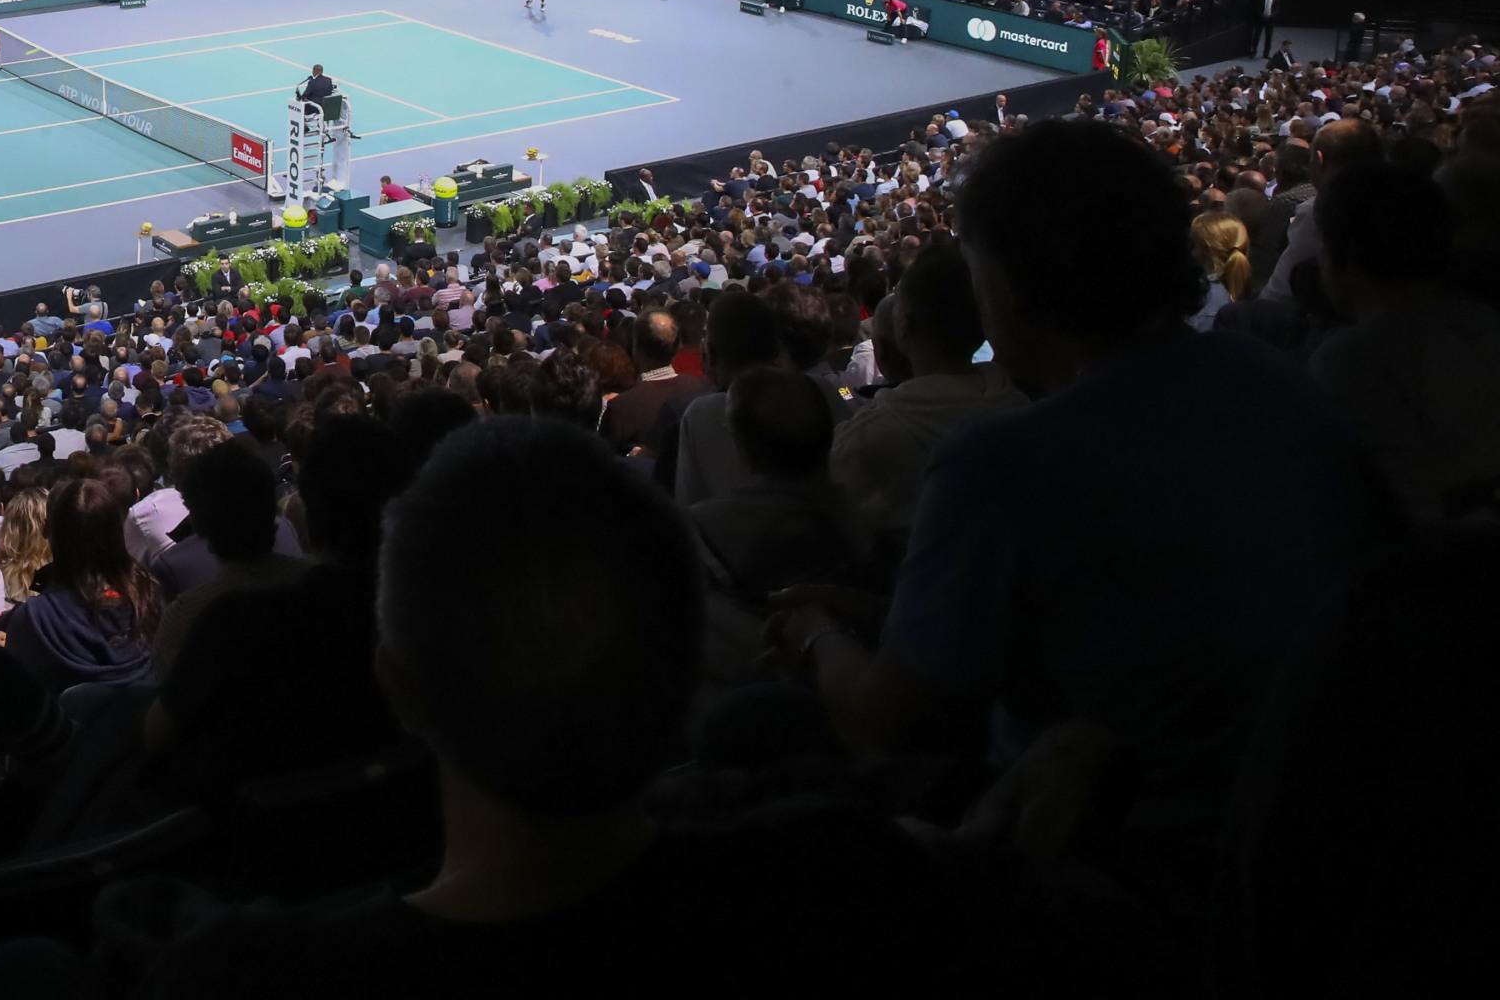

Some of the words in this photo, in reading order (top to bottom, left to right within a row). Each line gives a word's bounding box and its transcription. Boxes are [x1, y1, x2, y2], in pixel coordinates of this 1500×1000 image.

[846, 3, 888, 22] ROLEX
[1000, 30, 1068, 53] mastercard
[58, 84, 78, 100] ATP
[80, 91, 120, 118] WOLD
[122, 112, 153, 136] TOUR
[233, 146, 262, 169] Emirates
[243, 143, 252, 155] Fly
[289, 119, 300, 200] RICOH
